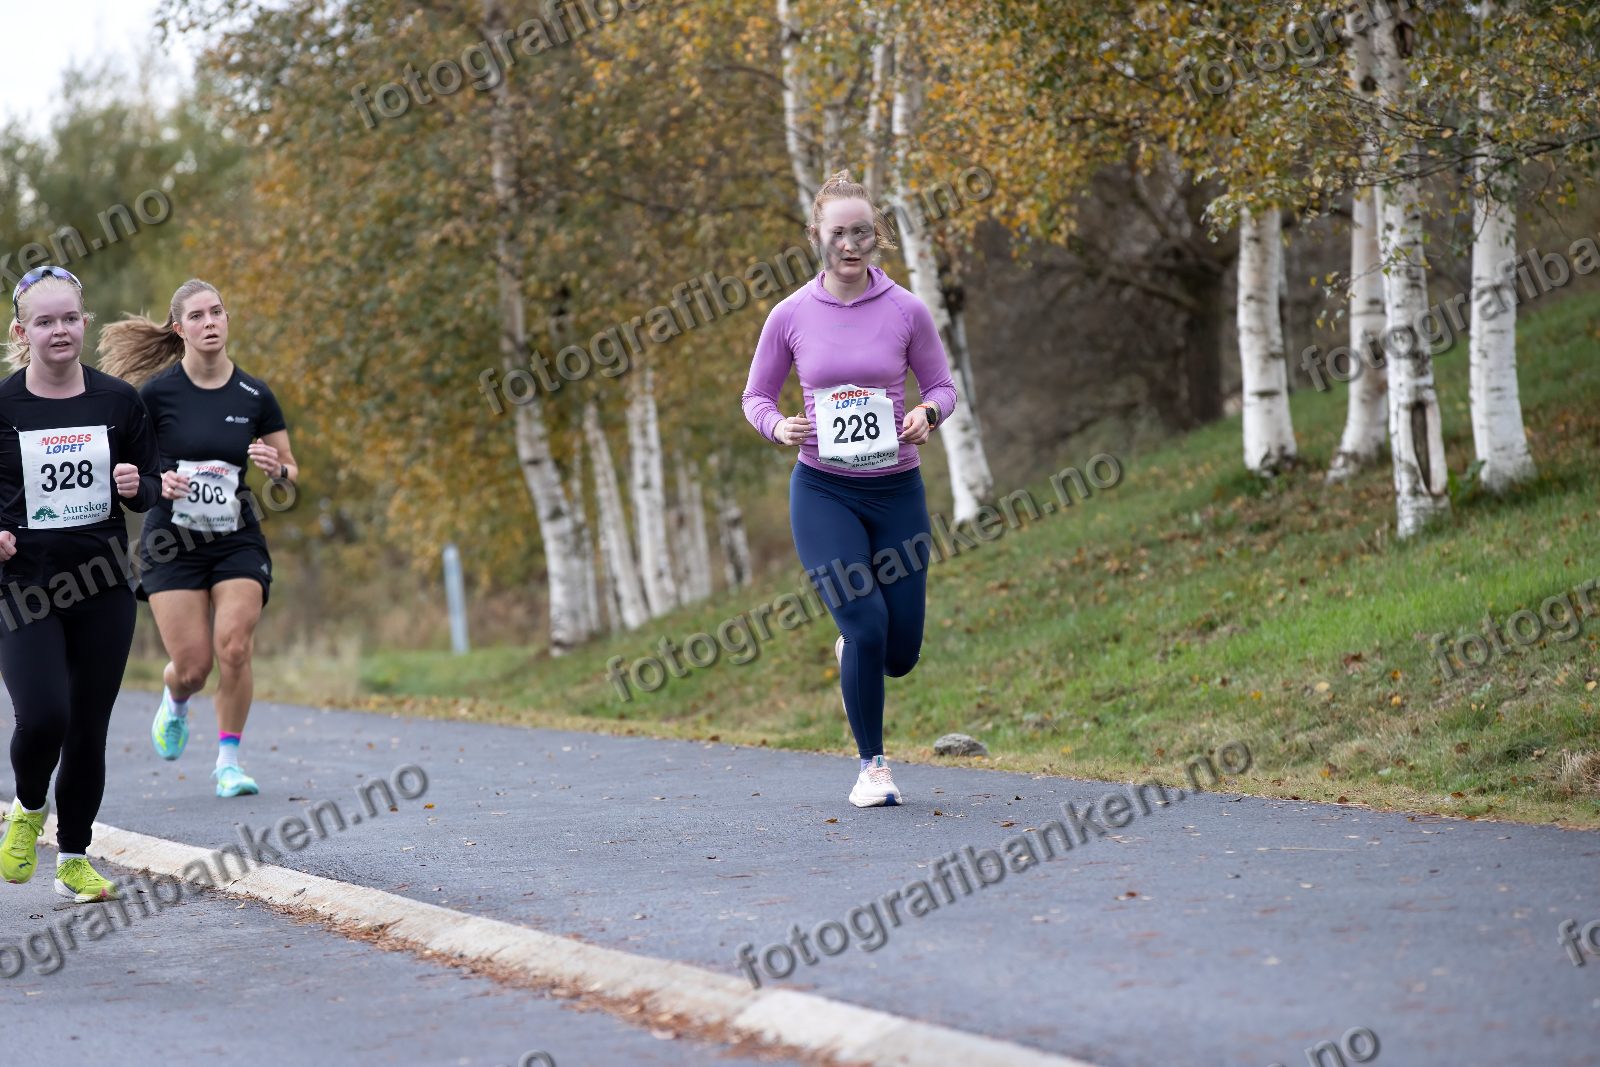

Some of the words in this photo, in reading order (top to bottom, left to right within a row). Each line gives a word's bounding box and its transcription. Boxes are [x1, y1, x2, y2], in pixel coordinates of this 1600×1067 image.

[833, 411, 881, 444] 228
[41, 433, 92, 446] NORGES
[45, 443, 84, 455] LØPET
[40, 459, 94, 493] 328
[187, 481, 227, 504] 308
[62, 501, 108, 515] Aurskog
